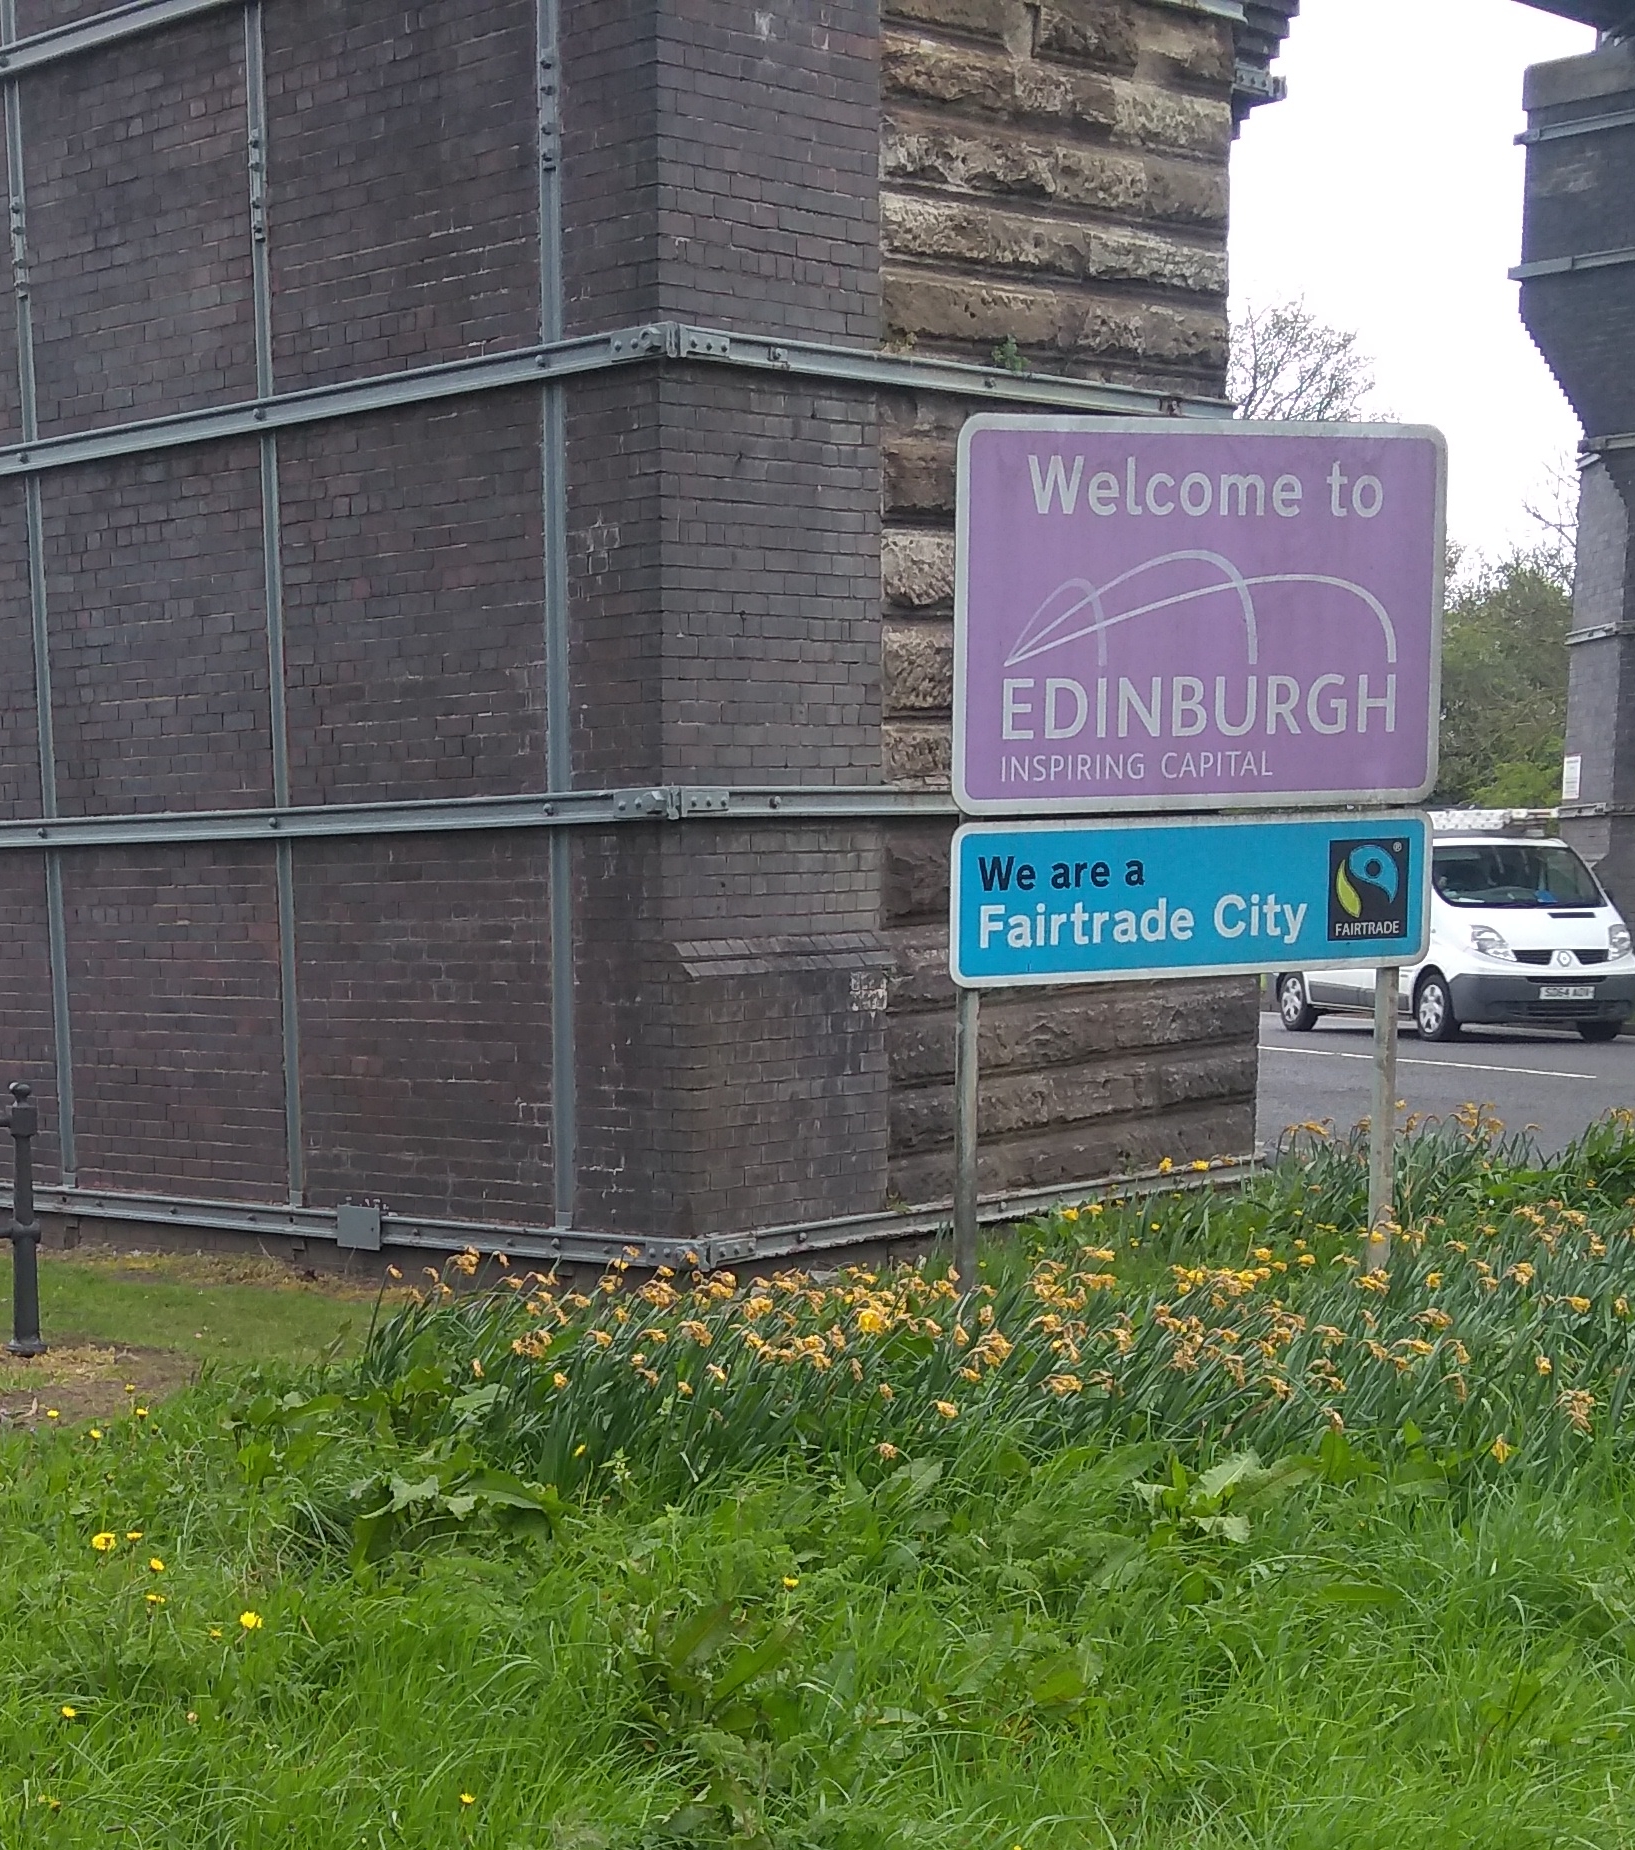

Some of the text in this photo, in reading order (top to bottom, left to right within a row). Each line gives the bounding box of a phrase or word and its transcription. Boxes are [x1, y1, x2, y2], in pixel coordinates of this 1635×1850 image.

[1027, 454, 1384, 518] Welcome to
[1001, 672, 1398, 741] EDINBURGH
[1000, 750, 1274, 783] INSPIRING CAPITAL
[977, 855, 1146, 892] We are a
[978, 892, 1308, 949] Fairtrade City
[1334, 920, 1400, 937] FAIRTRADE
